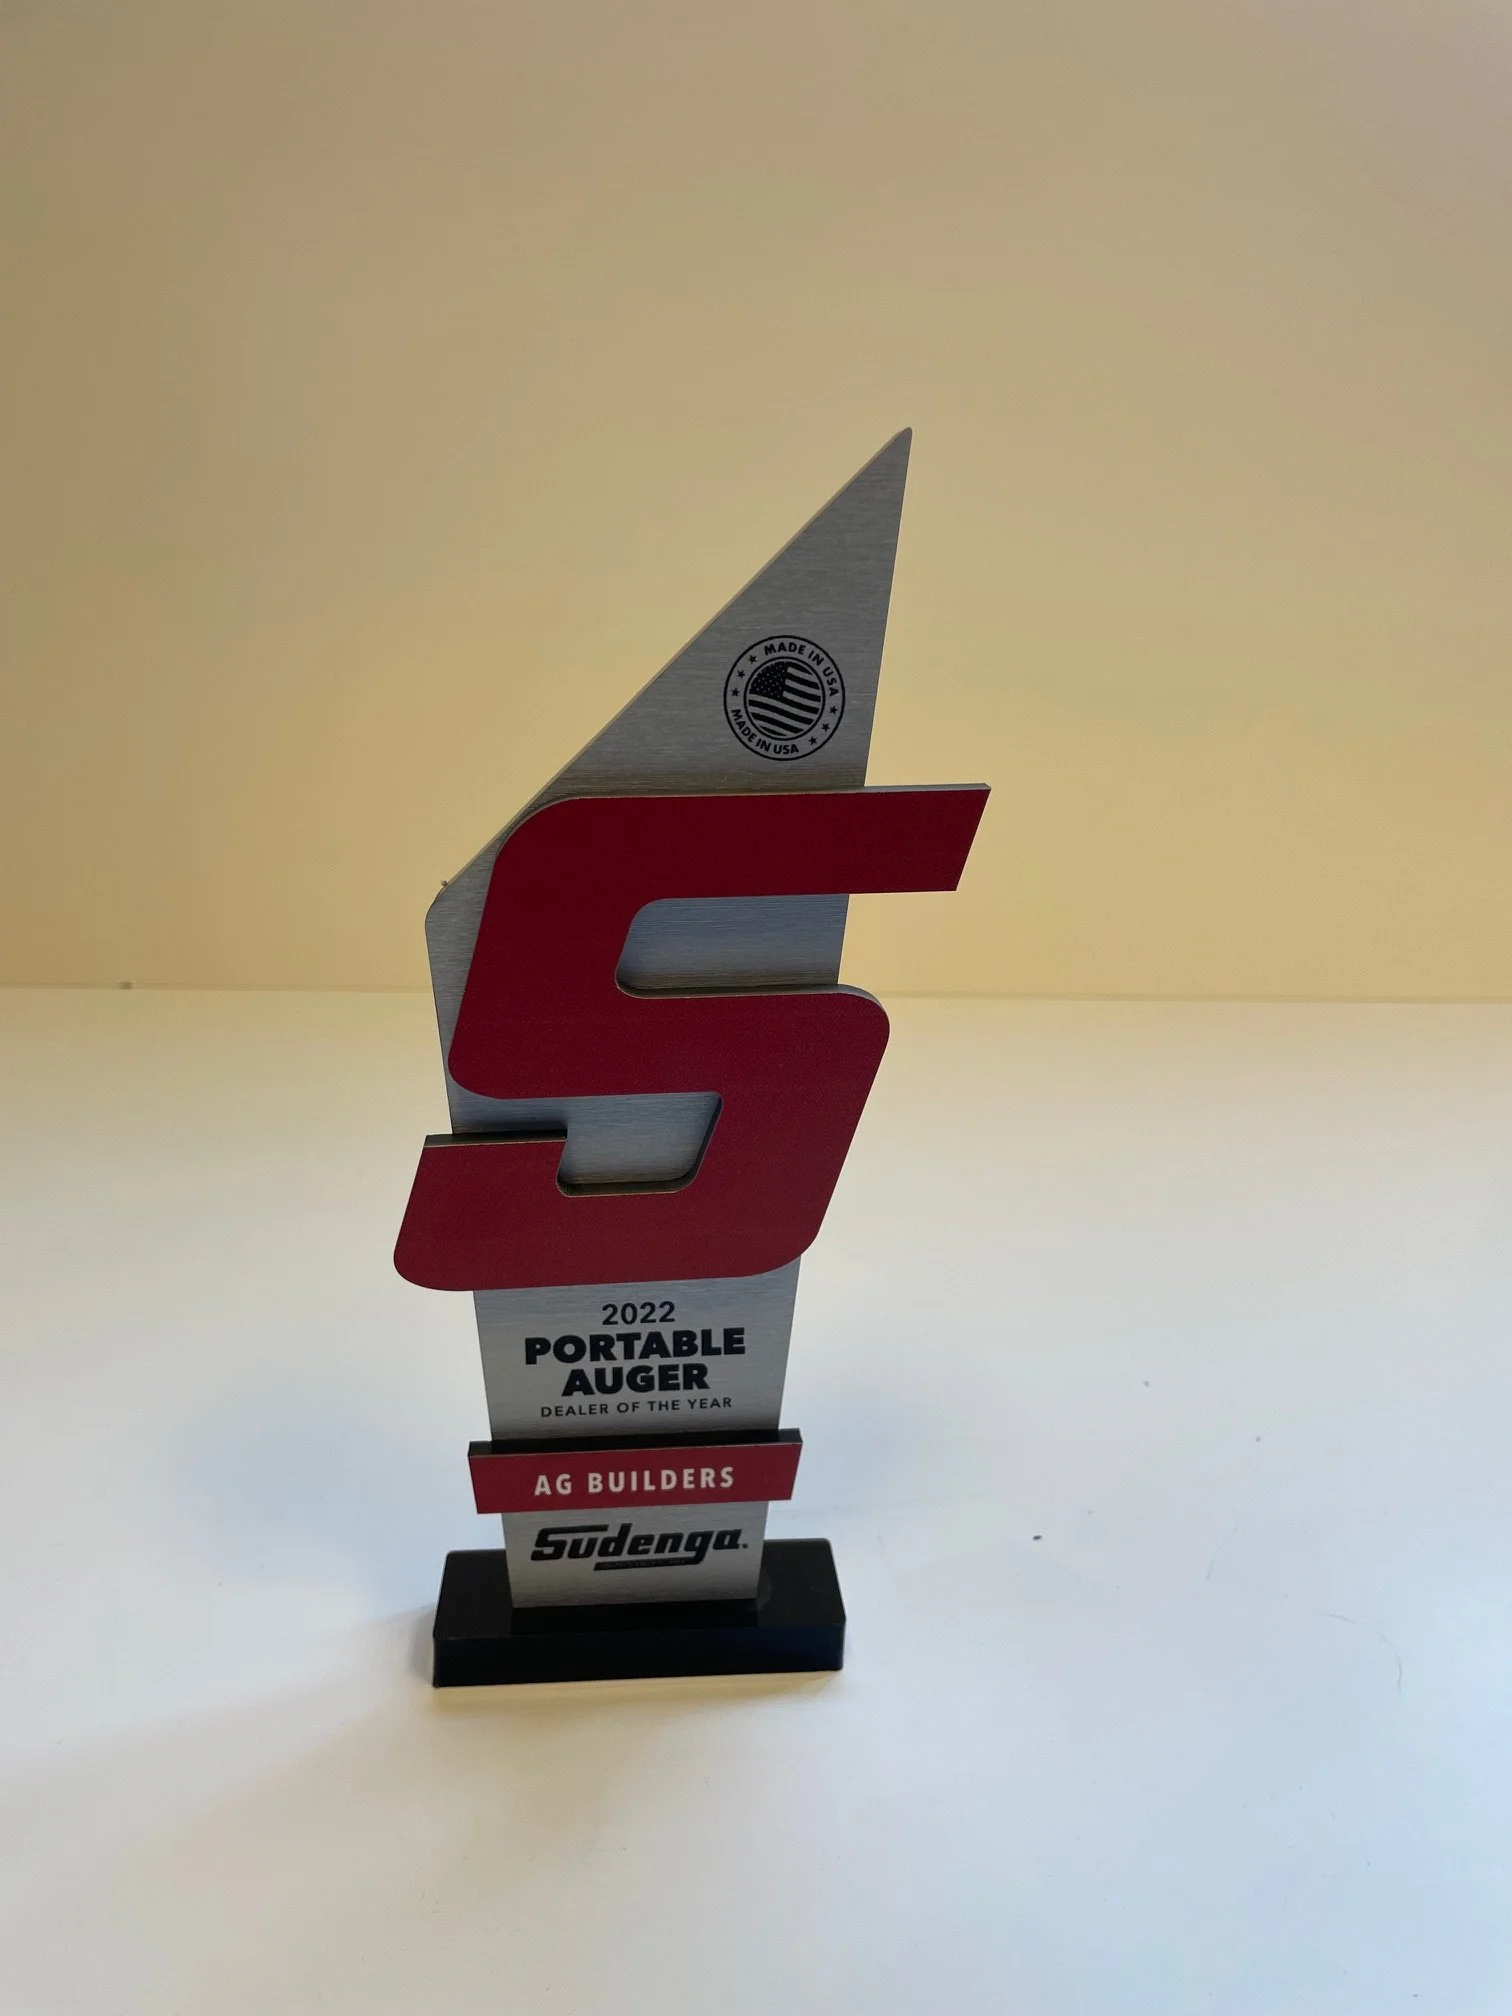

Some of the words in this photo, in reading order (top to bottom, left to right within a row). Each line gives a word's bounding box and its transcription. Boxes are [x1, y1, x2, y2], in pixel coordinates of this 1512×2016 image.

[764, 642, 806, 656] MADE
[808, 650, 824, 666] IN
[822, 666, 839, 697] USA
[731, 709, 757, 742] MADE
[755, 738, 772, 752] IN
[773, 744, 799, 754] USA
[602, 1301, 675, 1325] 2022
[525, 1327, 746, 1365] PORTABLE
[561, 1363, 711, 1397] AUGER
[541, 1404, 609, 1418] DEALER
[616, 1402, 640, 1413] OF
[648, 1399, 680, 1411] THE
[687, 1397, 732, 1410] YEAR
[534, 1473, 573, 1496] AG
[588, 1466, 734, 1494] BUILDERS
